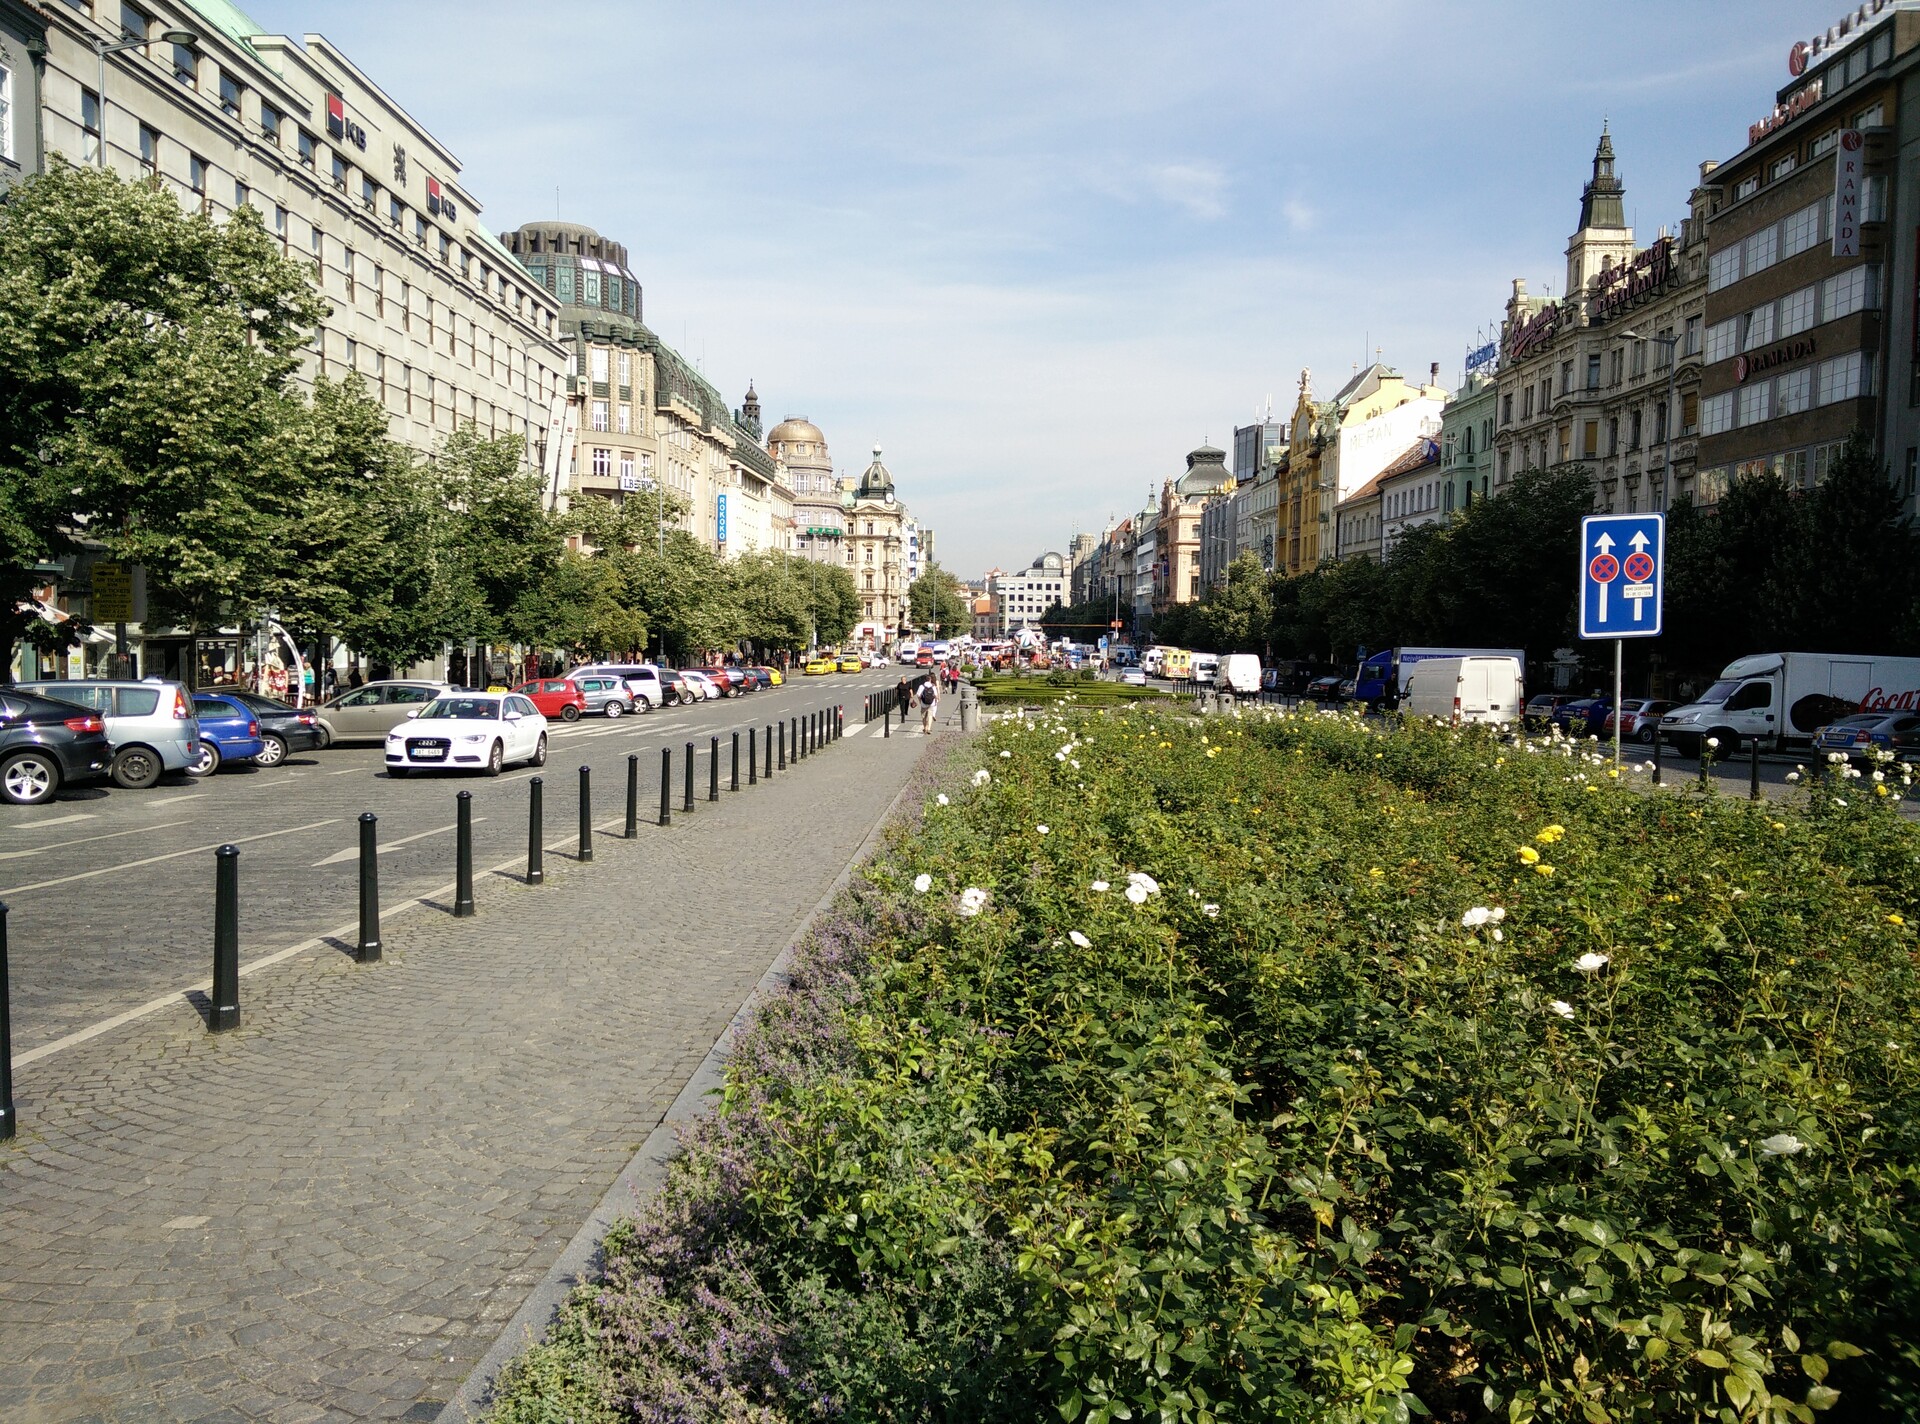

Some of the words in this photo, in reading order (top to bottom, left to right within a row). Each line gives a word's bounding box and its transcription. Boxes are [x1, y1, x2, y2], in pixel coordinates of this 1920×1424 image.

[1812, 0, 1894, 56] RAMAD
[1789, 79, 1823, 121] KNIH
[344, 117, 367, 153] KB
[440, 195, 457, 222] KB
[1841, 160, 1856, 255] RAMADA
[1749, 338, 1816, 372] RAMADA
[1350, 423, 1392, 450] MERAN
